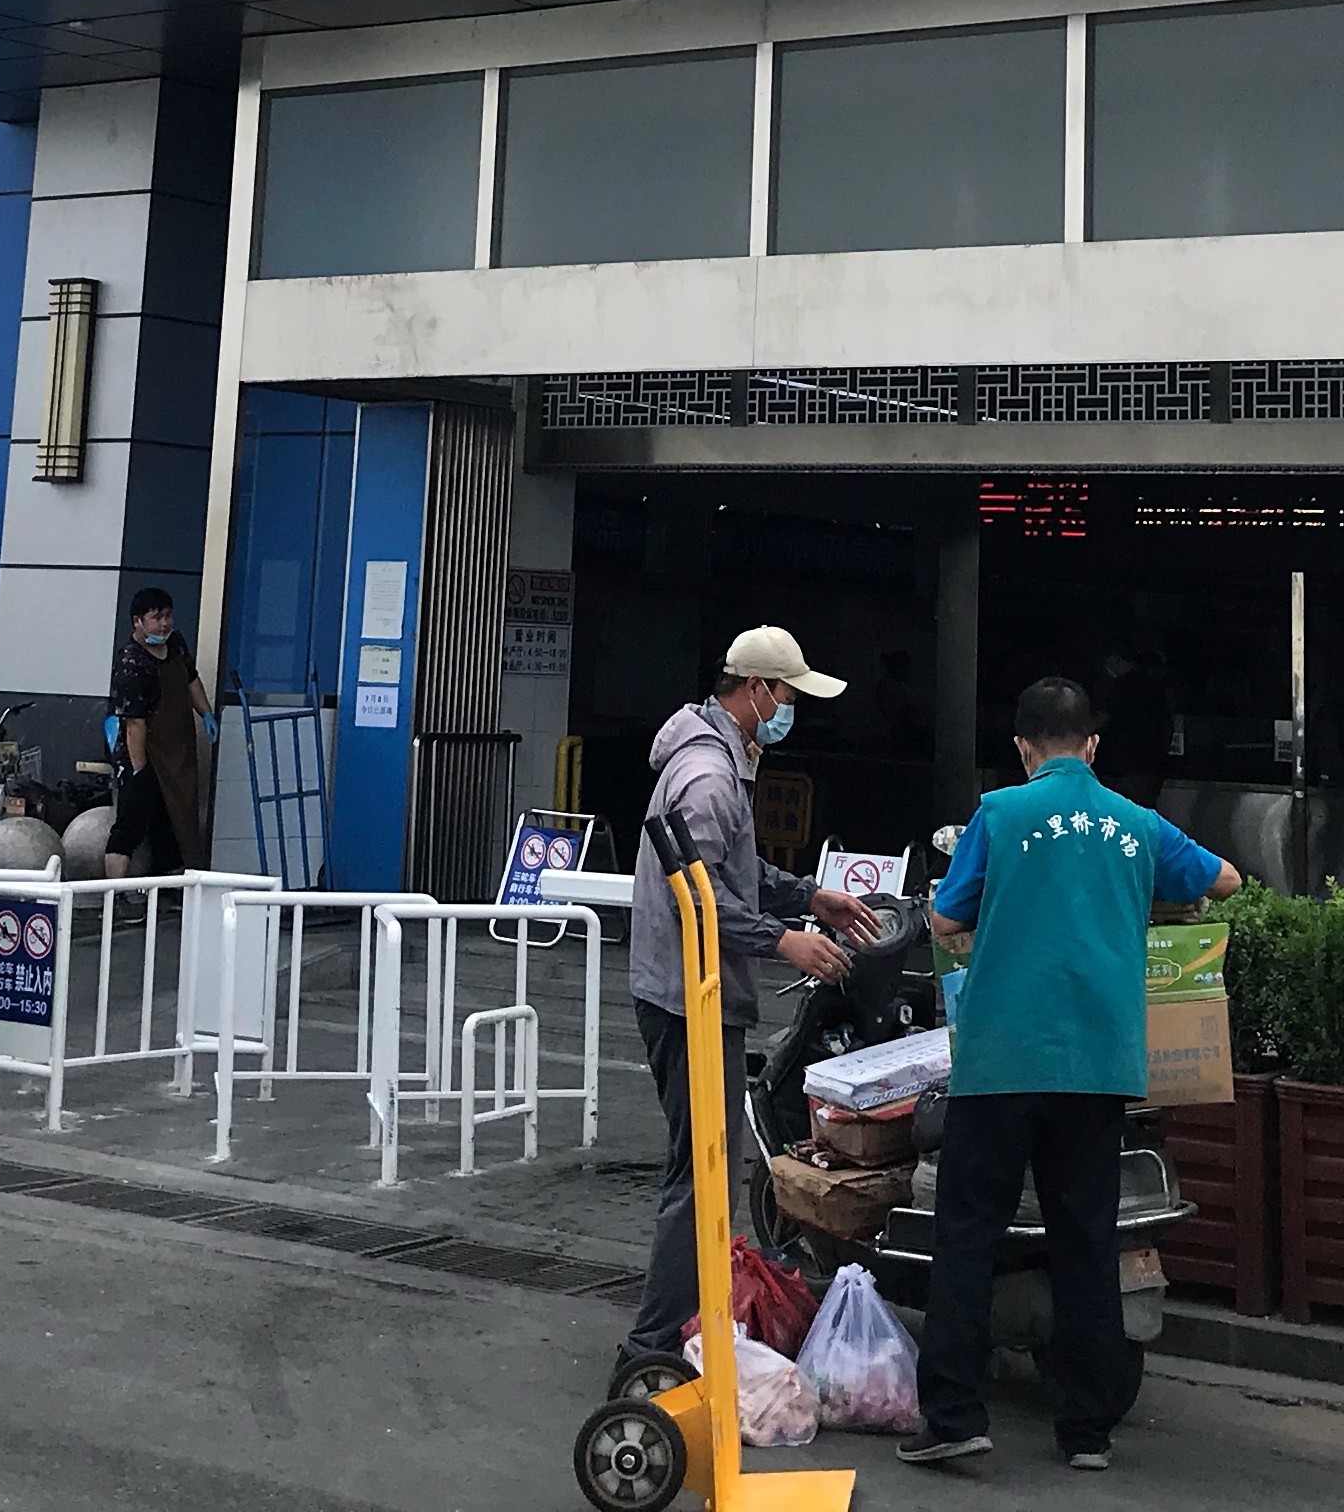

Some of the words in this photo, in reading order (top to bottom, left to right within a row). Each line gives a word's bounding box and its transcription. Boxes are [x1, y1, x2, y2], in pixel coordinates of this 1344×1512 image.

[515, 629, 556, 644] 营业时间
[1021, 810, 1140, 858] 八里桥市场
[834, 855, 847, 869] 厅
[882, 859, 895, 873] 内
[512, 871, 537, 883] 三轮车
[509, 882, 534, 895] 自行车
[15, 963, 53, 996] 禁止入内
